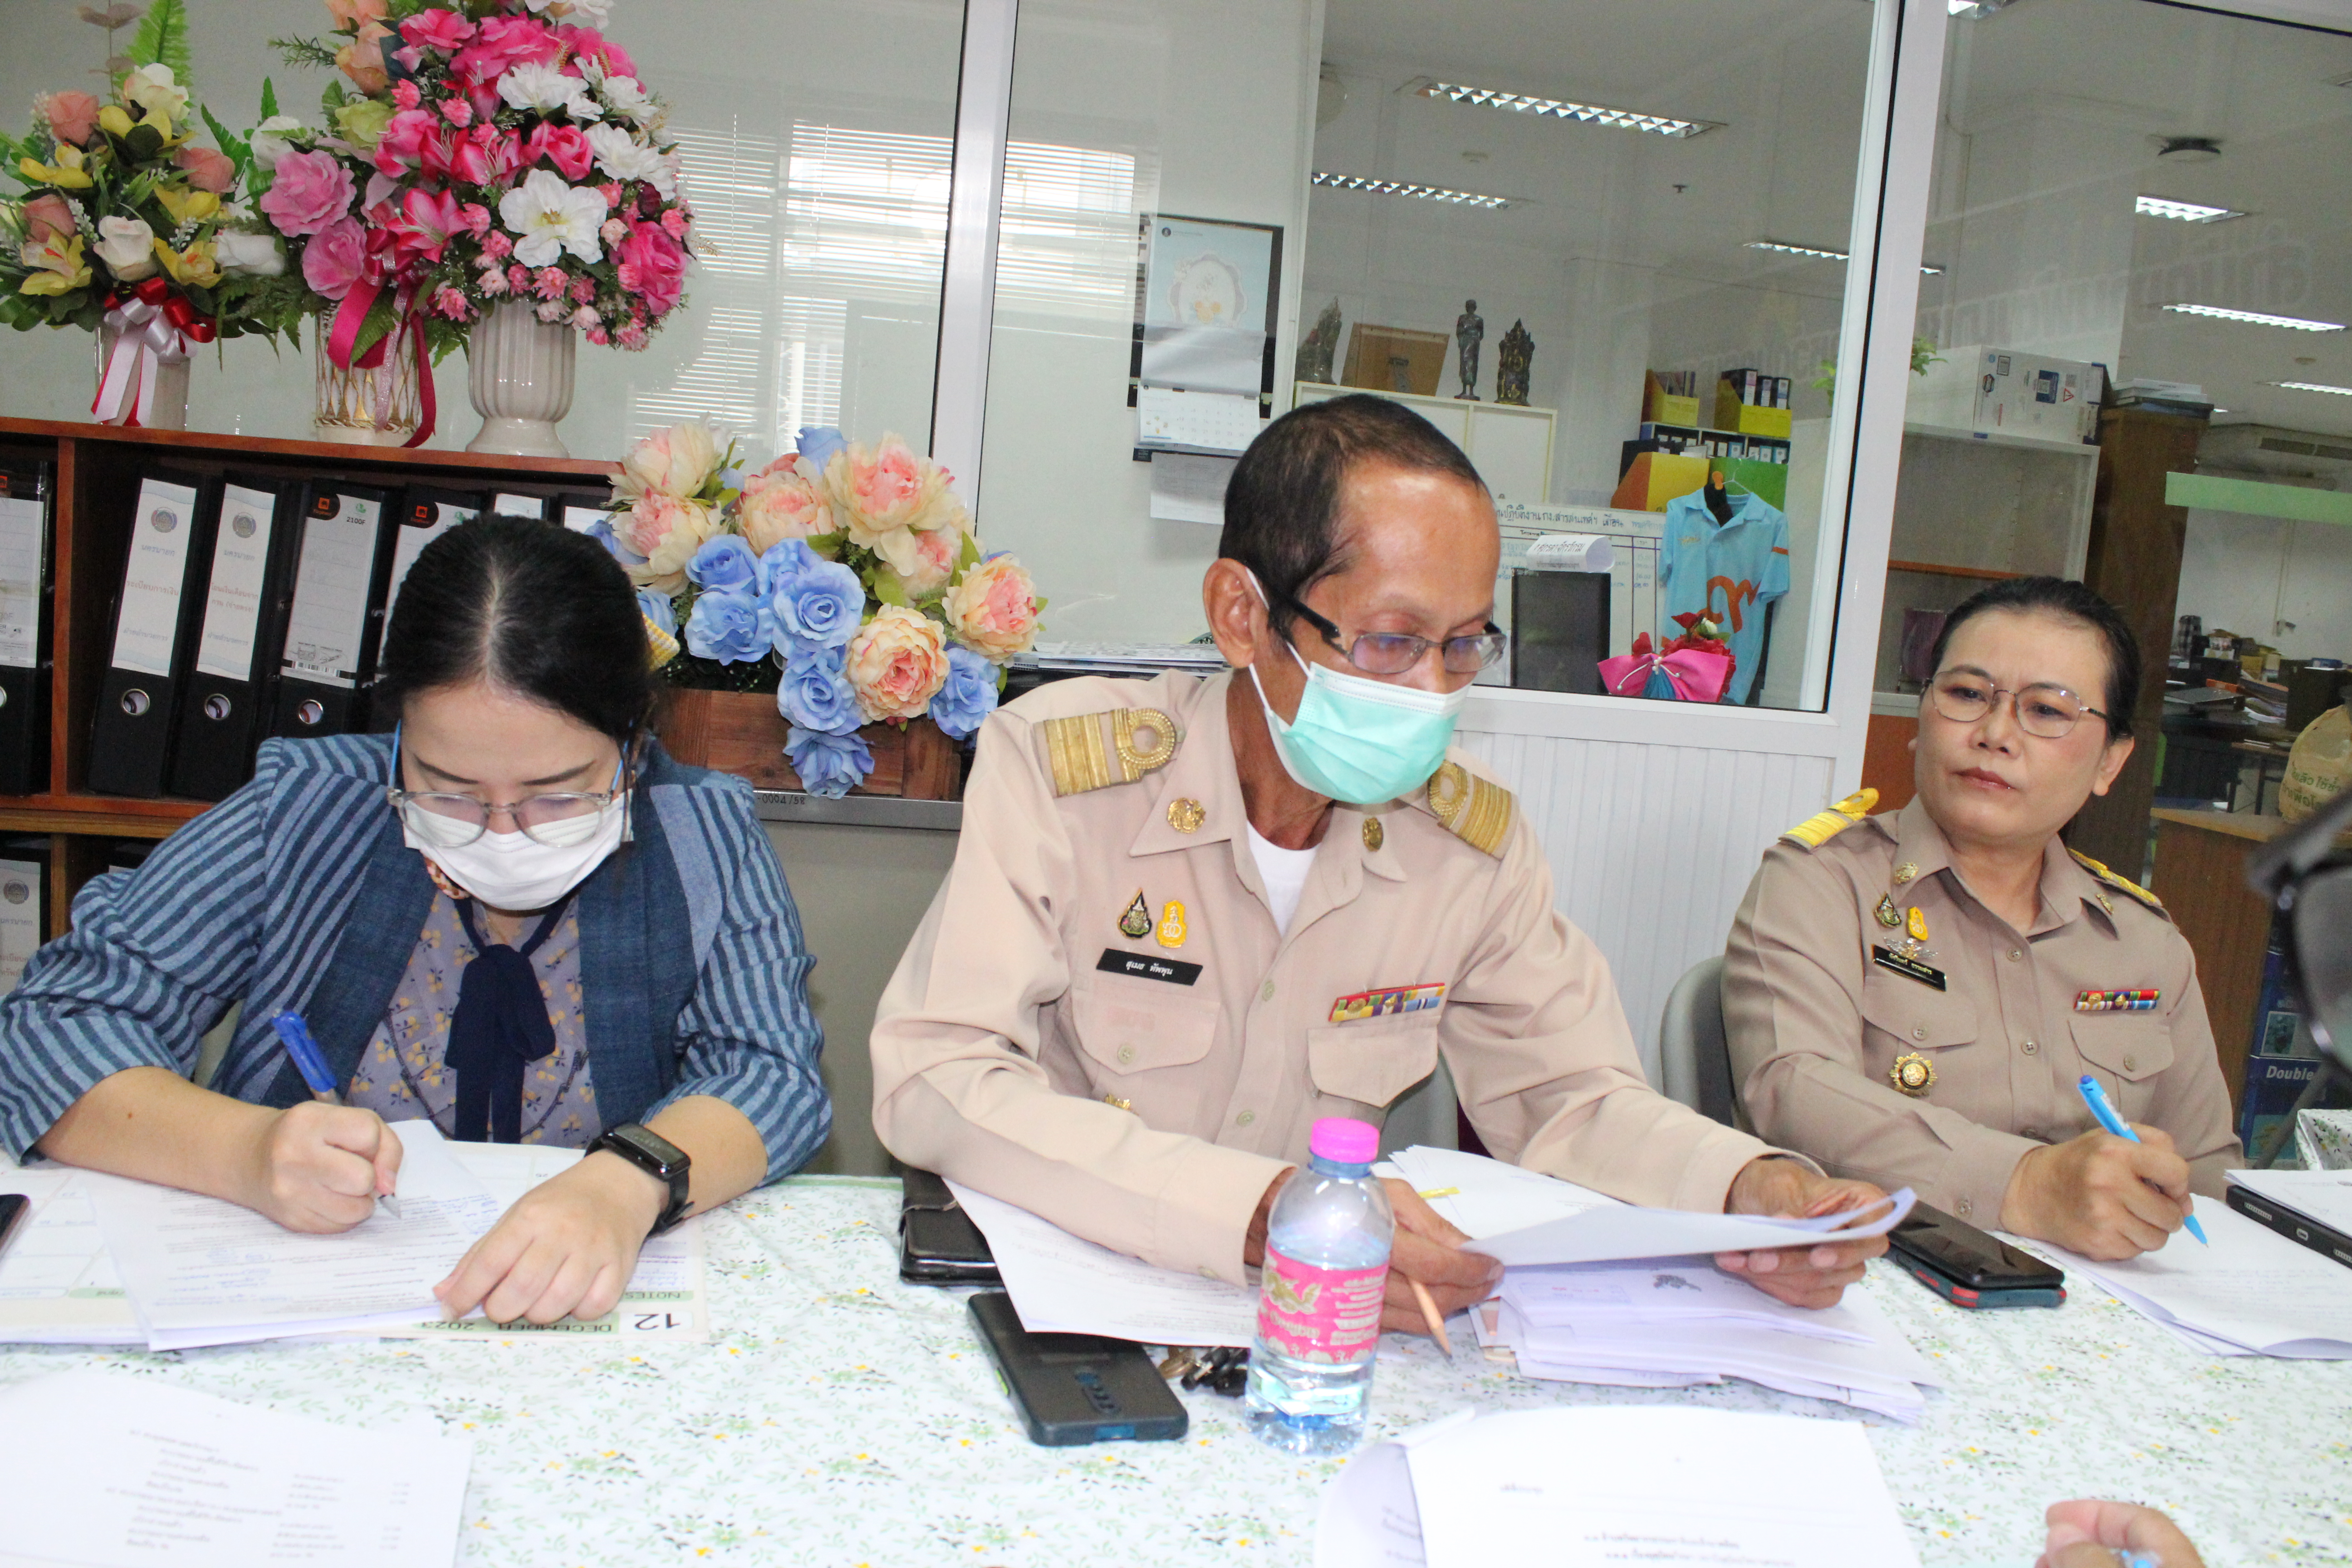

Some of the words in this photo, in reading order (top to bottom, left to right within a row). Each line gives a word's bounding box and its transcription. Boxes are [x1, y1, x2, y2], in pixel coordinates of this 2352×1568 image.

[347, 517, 366, 525] 2100F
[2266, 1065, 2314, 1081] Double
[420, 1320, 475, 1331] 2023
[633, 1313, 681, 1330] 12
